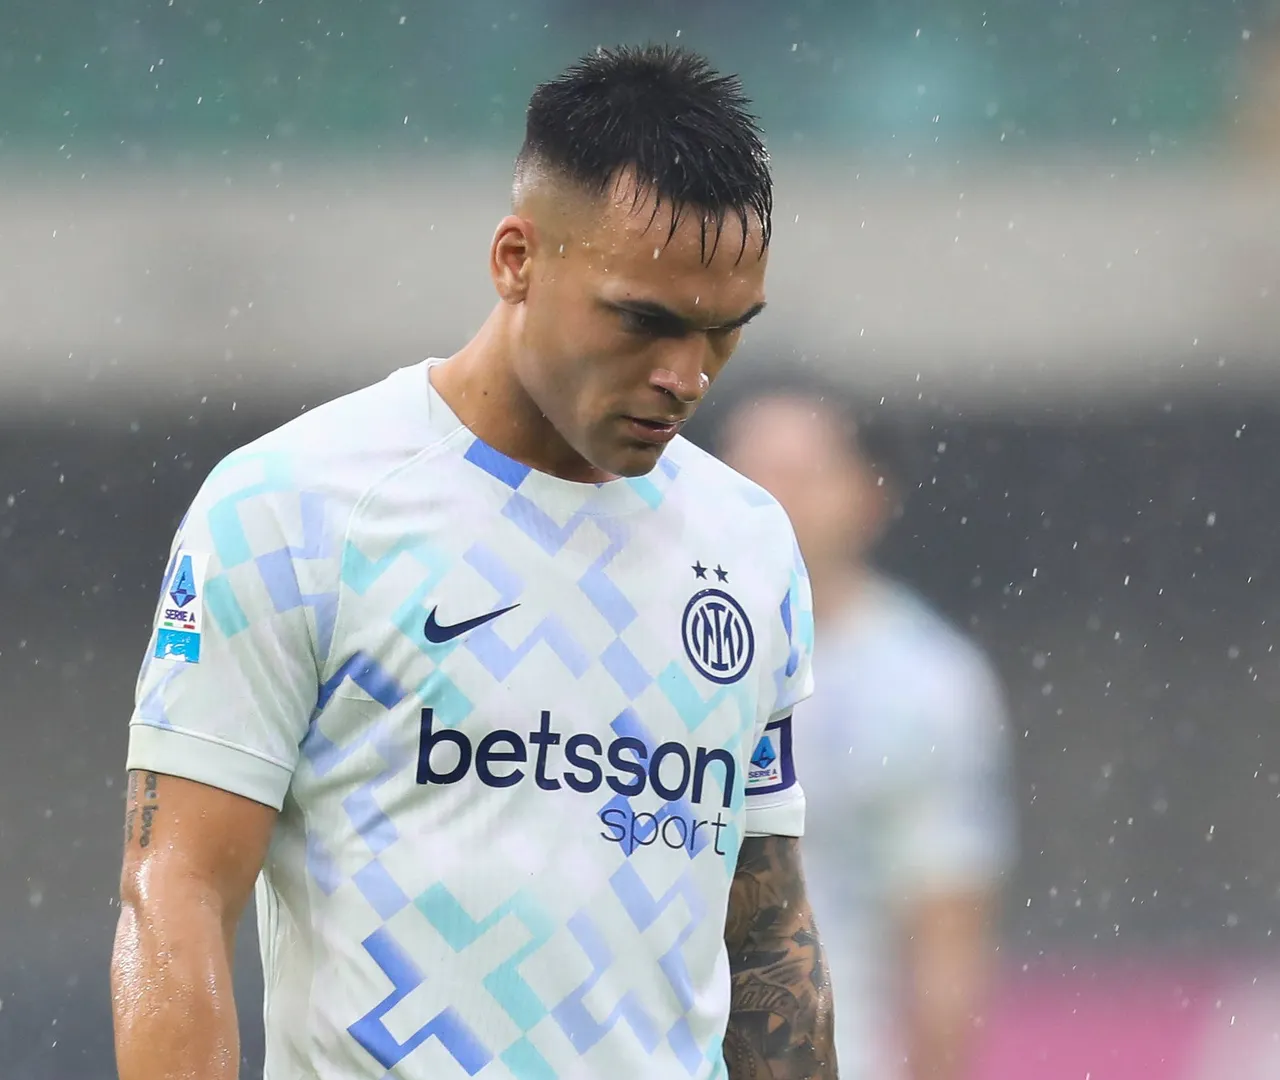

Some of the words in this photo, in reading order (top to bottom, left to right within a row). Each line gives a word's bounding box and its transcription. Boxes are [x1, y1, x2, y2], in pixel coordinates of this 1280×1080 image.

[165, 609, 188, 621] SERIE
[189, 612, 196, 623] A
[415, 707, 736, 809] betsson
[748, 769, 771, 779] SERIE
[599, 808, 728, 856] sport
